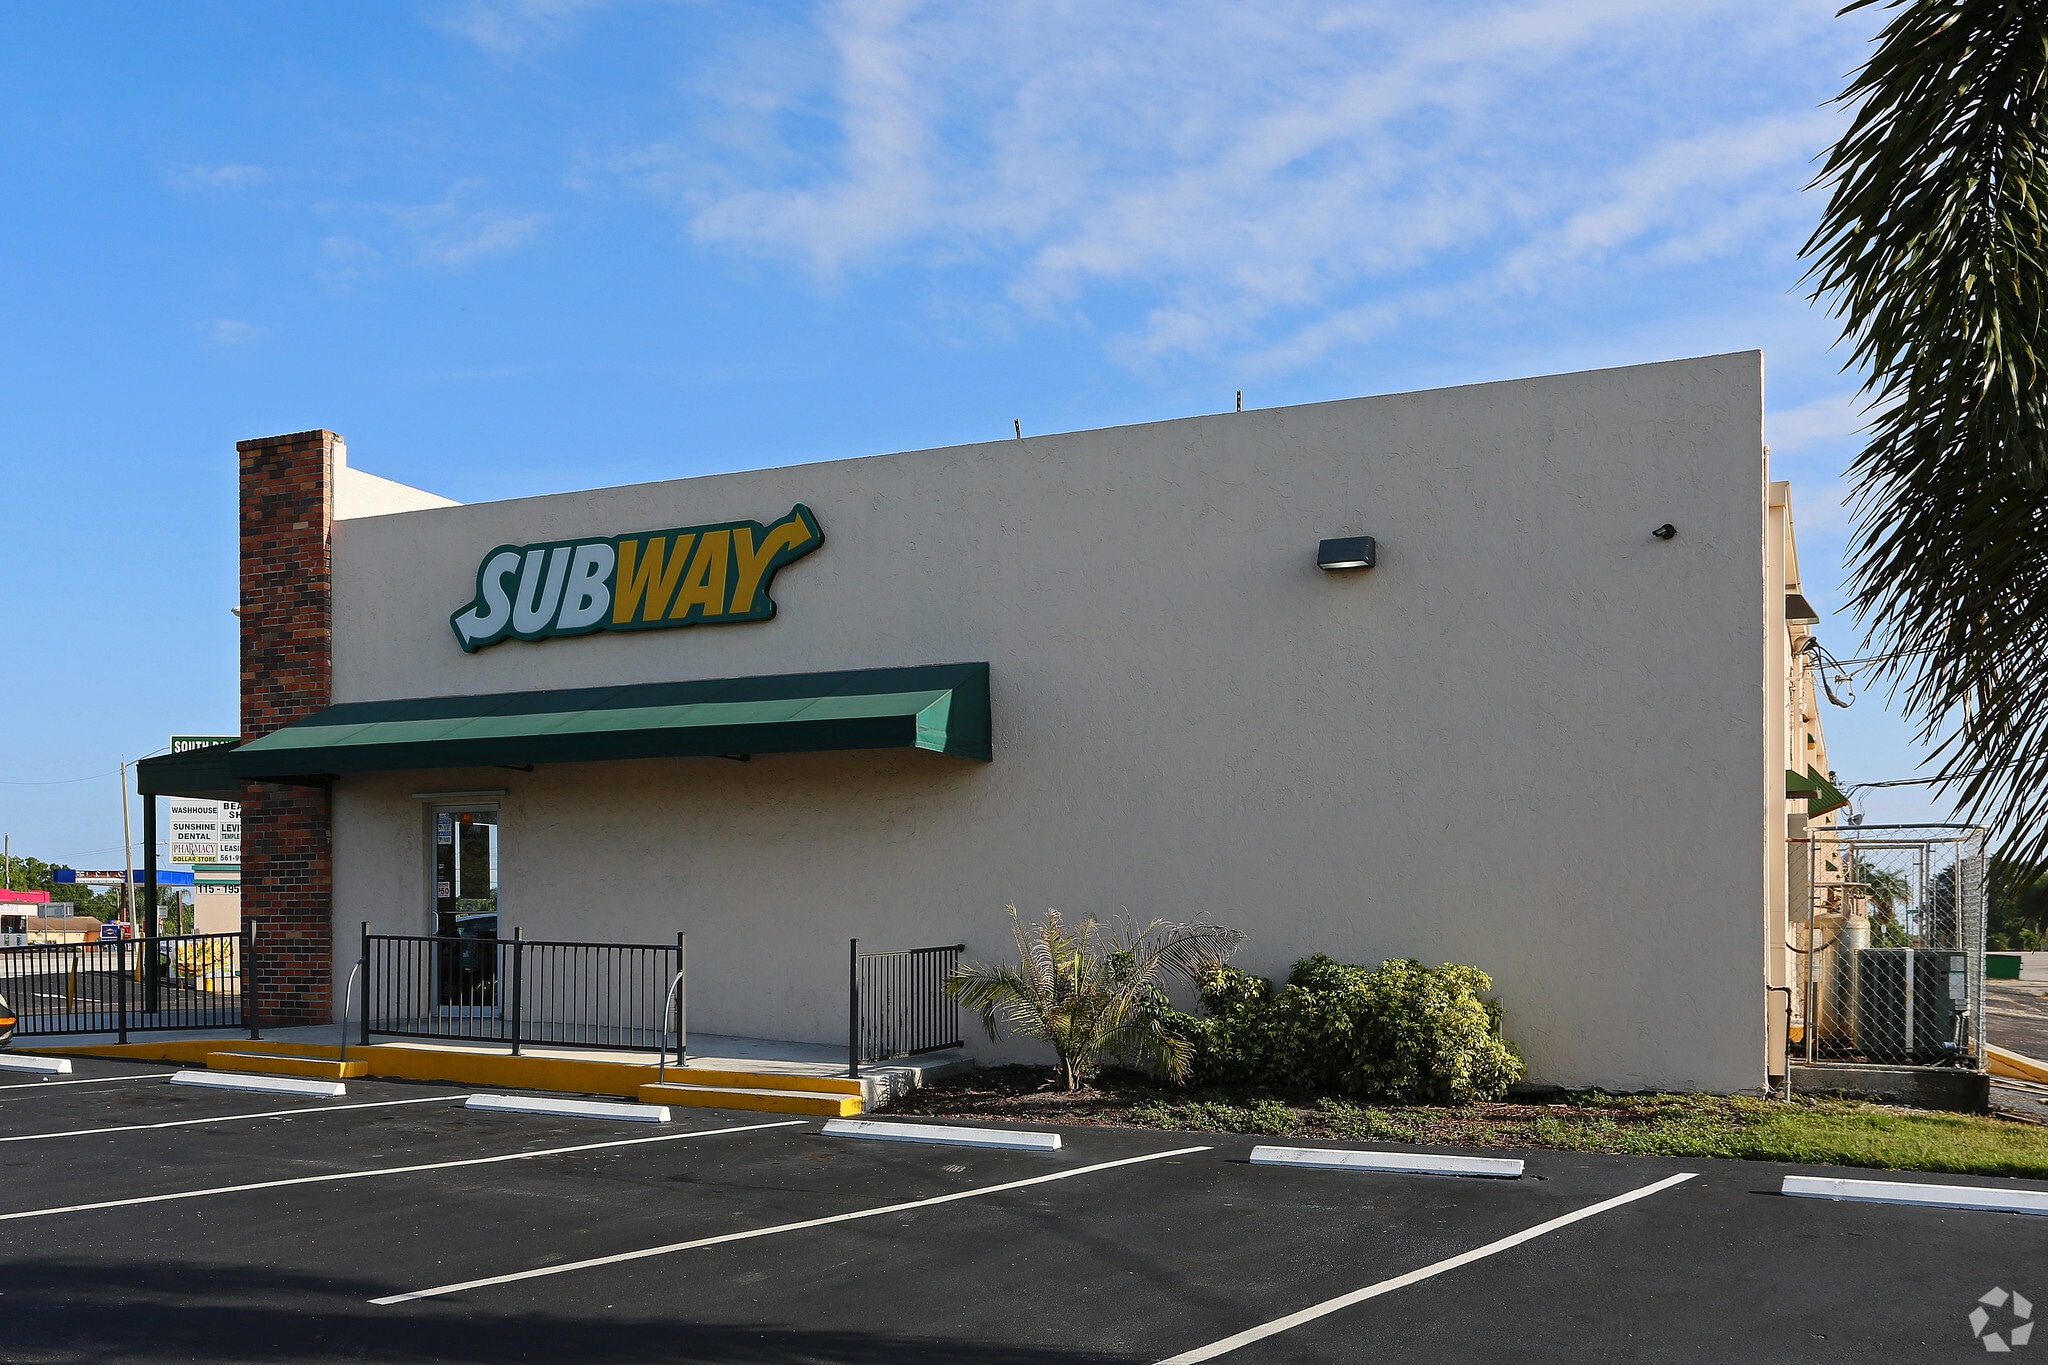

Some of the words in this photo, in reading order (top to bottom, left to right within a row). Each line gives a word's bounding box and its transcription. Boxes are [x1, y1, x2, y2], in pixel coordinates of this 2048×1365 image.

[455, 513, 811, 645] SUBWAY
[173, 823, 216, 831] SUNSHINE
[221, 824, 241, 832] LEVI
[197, 884, 214, 894] 115
[222, 884, 240, 894] 195
